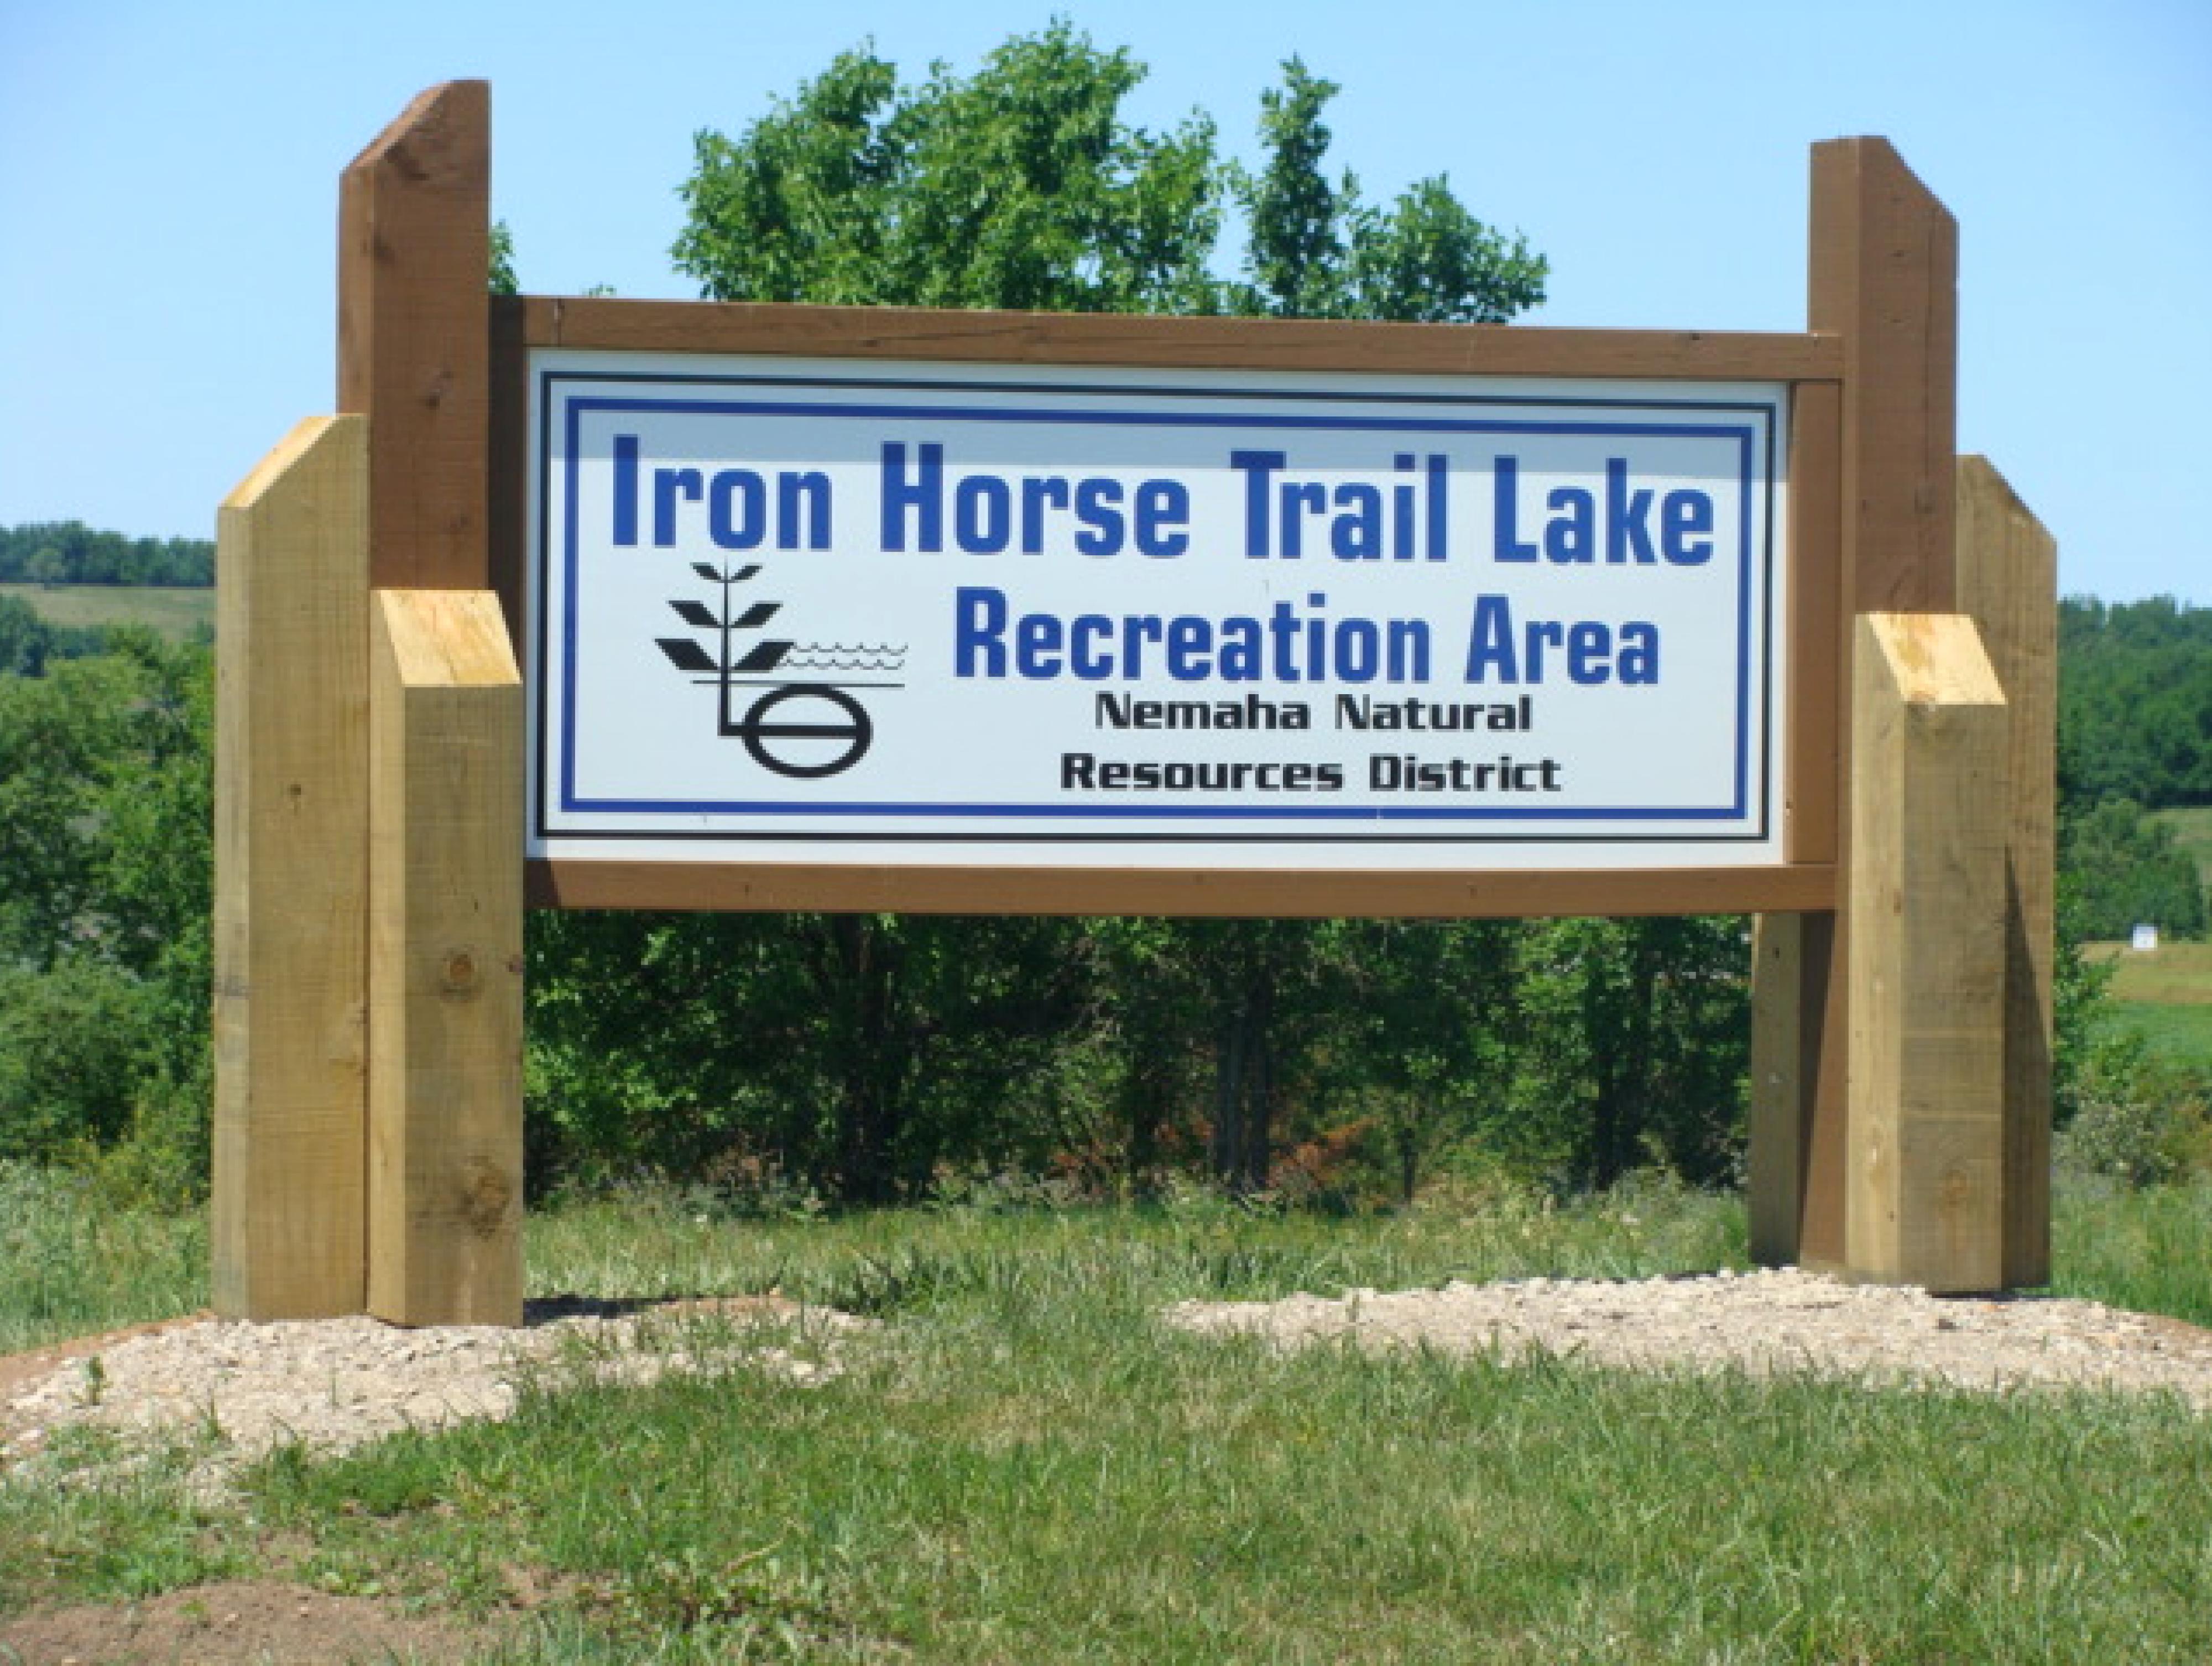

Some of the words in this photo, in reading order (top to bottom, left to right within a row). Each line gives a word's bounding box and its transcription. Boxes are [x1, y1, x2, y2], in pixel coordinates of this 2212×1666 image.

[612, 433, 833, 550] Iron
[879, 439, 1190, 558] Horse
[1227, 446, 1451, 561] Trail
[1493, 453, 1714, 567] Lake
[956, 586, 1430, 685] Recreation
[1465, 592, 1659, 685] Area
[1094, 690, 1312, 731] Nemaha
[1334, 693, 1531, 731] Natural
[1060, 752, 1343, 792] Resources
[1369, 755, 1563, 793] District
